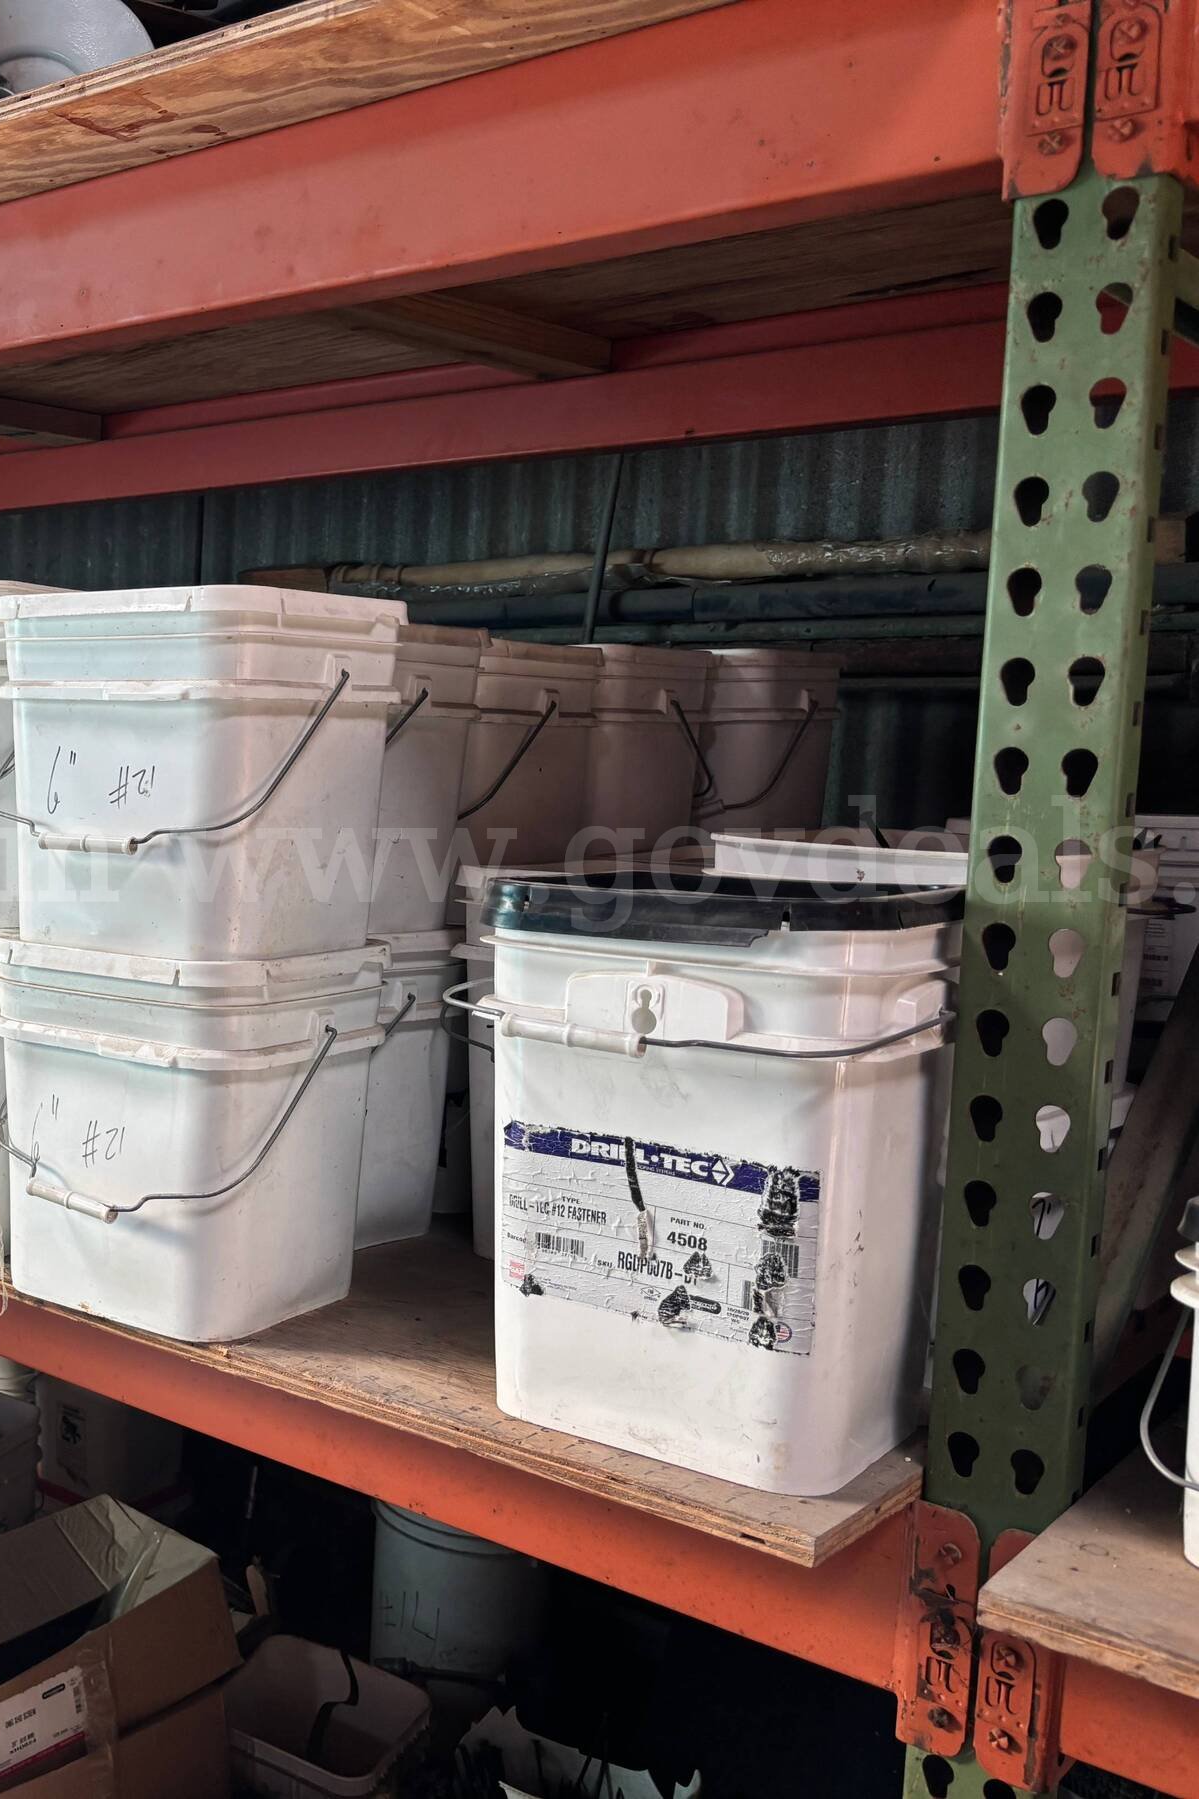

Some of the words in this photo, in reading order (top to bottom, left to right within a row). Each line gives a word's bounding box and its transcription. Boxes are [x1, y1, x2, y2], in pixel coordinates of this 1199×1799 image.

[82, 1119, 126, 1169] #21
[567, 1206, 607, 1226] FASTENER
[670, 1216, 691, 1227] PART
[666, 1230, 708, 1252] 4508
